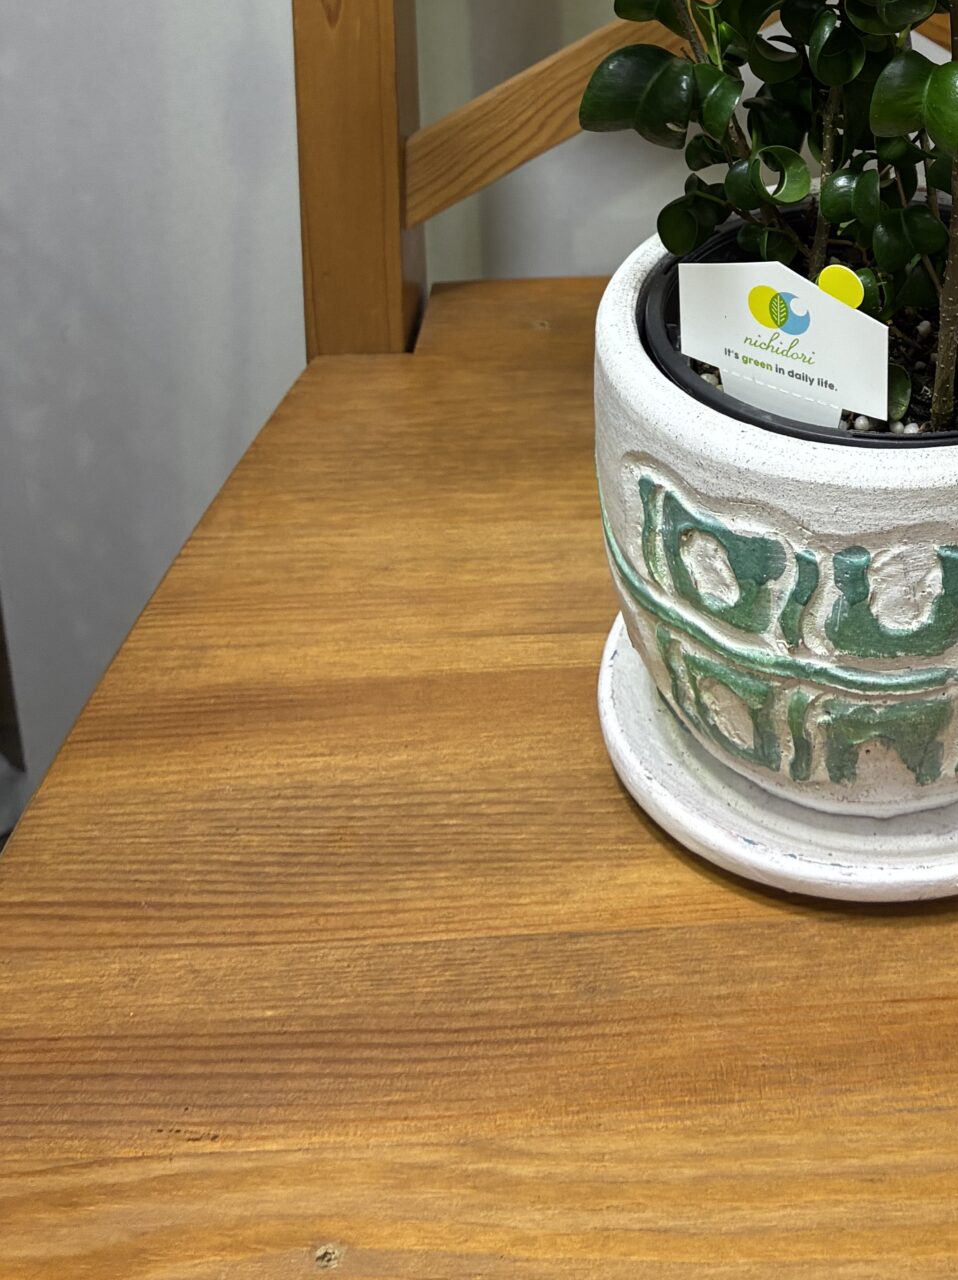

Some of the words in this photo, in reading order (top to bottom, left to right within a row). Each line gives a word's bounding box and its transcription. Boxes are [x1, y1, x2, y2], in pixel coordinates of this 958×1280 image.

[743, 331, 816, 365] nichidori
[724, 347, 740, 360] It's
[741, 355, 773, 371] green
[775, 364, 785, 375] in
[787, 370, 815, 386] daily
[817, 377, 838, 391] life.
